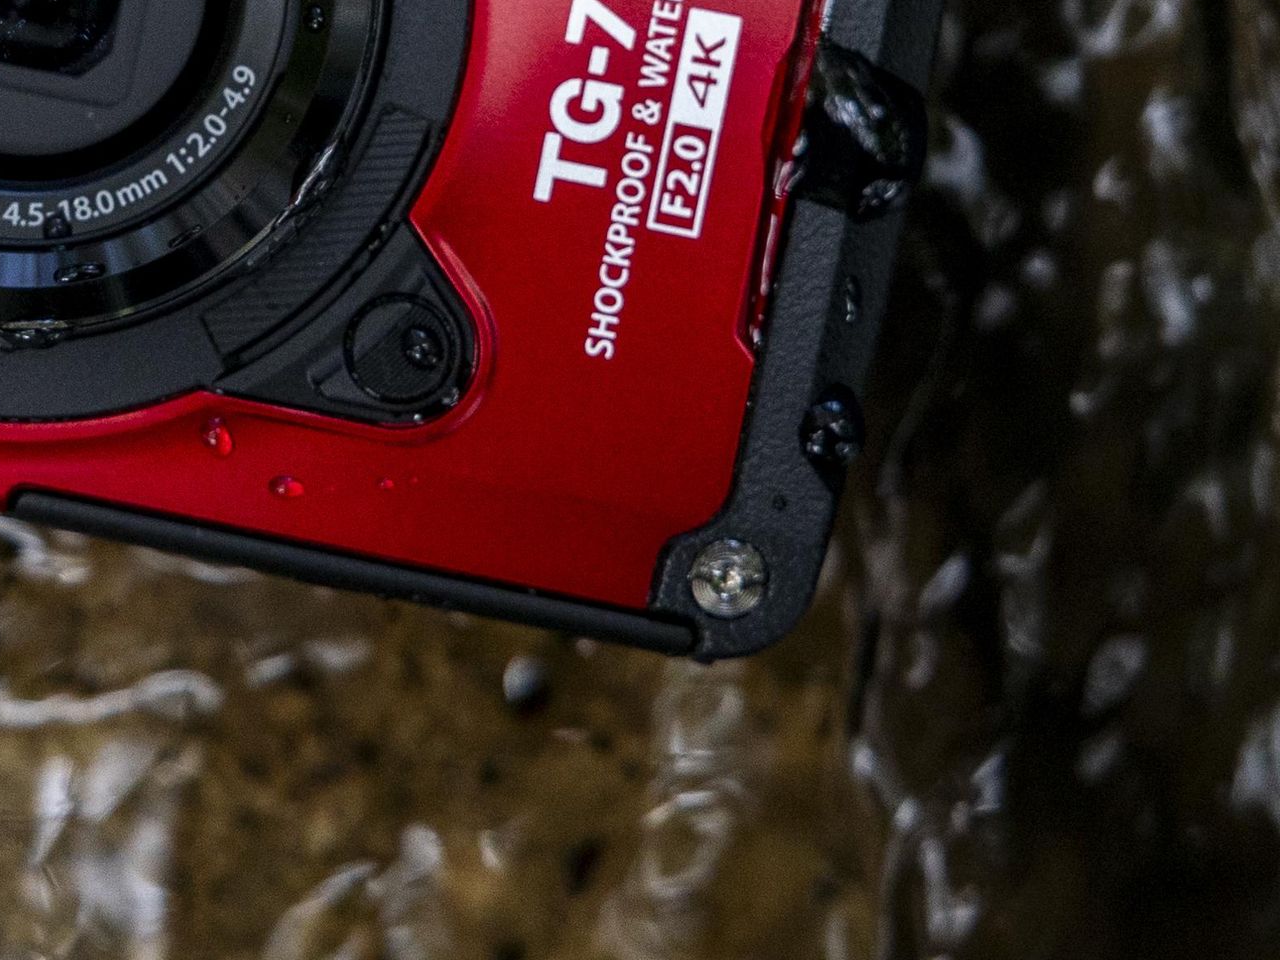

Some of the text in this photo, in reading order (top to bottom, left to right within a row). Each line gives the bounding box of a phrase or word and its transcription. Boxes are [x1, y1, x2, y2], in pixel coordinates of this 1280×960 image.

[585, 132, 653, 360] SHOCKPROOF
[632, 99, 662, 126] &
[660, 32, 726, 218] F2.0 4K
